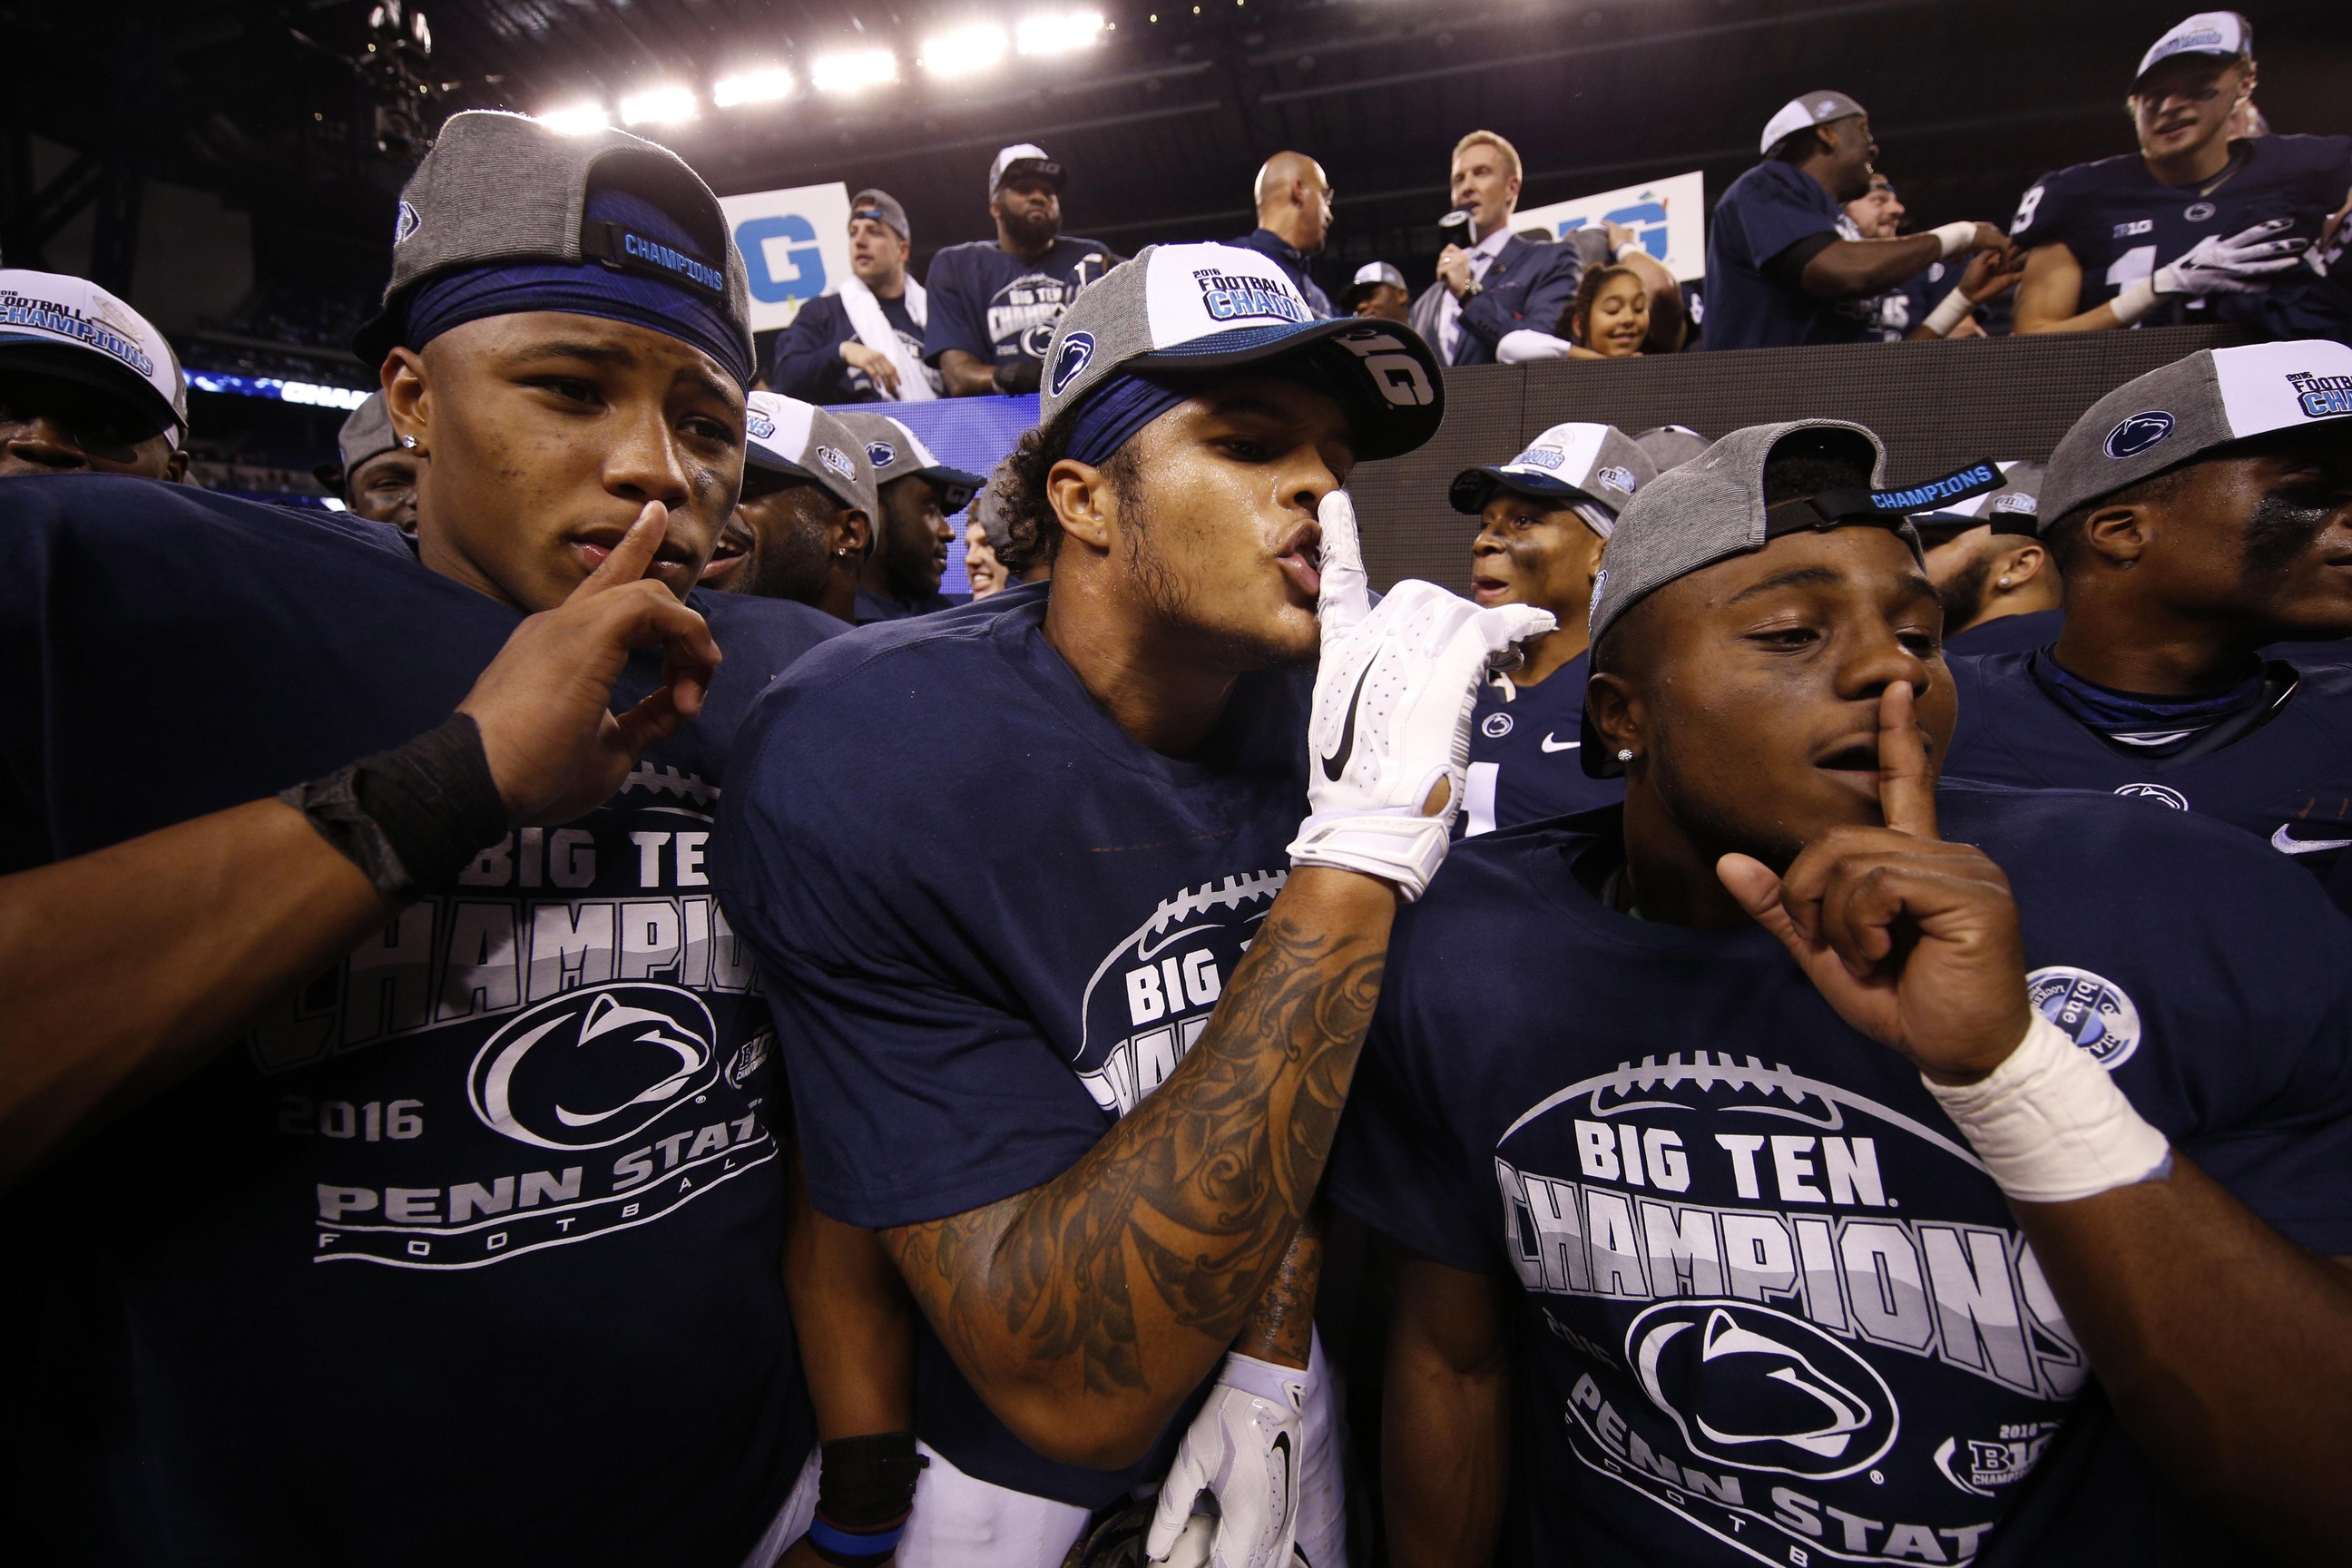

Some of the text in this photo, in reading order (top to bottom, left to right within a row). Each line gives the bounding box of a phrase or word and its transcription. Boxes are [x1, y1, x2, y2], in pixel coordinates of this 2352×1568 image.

[625, 233, 723, 291] CHAMPIONS
[1198, 276, 1289, 297] FOOTBALL
[2291, 376, 2352, 393] FOOTB
[1870, 465, 1994, 509] CHAMPIONS
[458, 827, 597, 888] BIG
[1126, 947, 1222, 1027] BIG
[2061, 980, 2100, 1024] blue
[278, 1094, 425, 1142] 2016
[1573, 1118, 1886, 1208] BIG TEN
[316, 1165, 583, 1224] PENN
[1571, 1372, 1744, 1505] PENN
